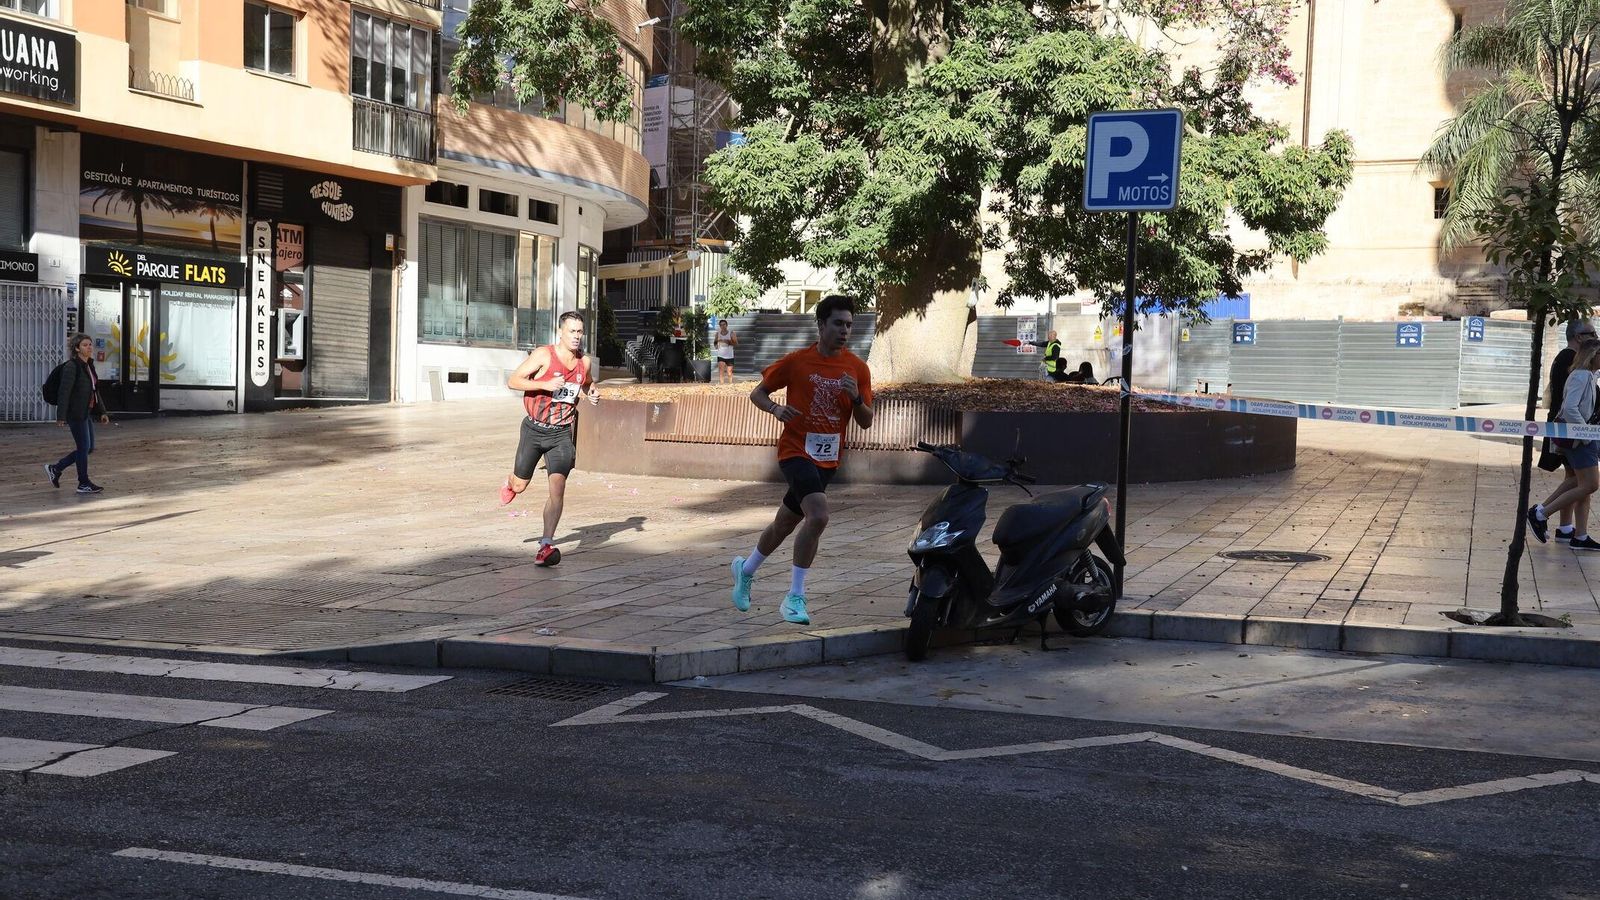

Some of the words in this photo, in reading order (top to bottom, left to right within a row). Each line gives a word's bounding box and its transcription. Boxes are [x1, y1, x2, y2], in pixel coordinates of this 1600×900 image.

[2, 28, 59, 72] UANA
[1091, 120, 1150, 198] P
[84, 170, 120, 184] GESTIÓN
[122, 176, 132, 186] DE
[137, 179, 193, 196] APARTAMENTOS
[197, 187, 240, 202] TURÍSTICOS
[322, 180, 342, 200] SOLE
[1118, 186, 1169, 201] MOTOS
[322, 201, 354, 222] HUNTERS
[137, 262, 180, 279] PARQUE
[185, 264, 226, 284] FLATS
[257, 236, 266, 368] SNEAKERS
[816, 443, 832, 453] 72
[1035, 584, 1057, 607] YAMAHA
